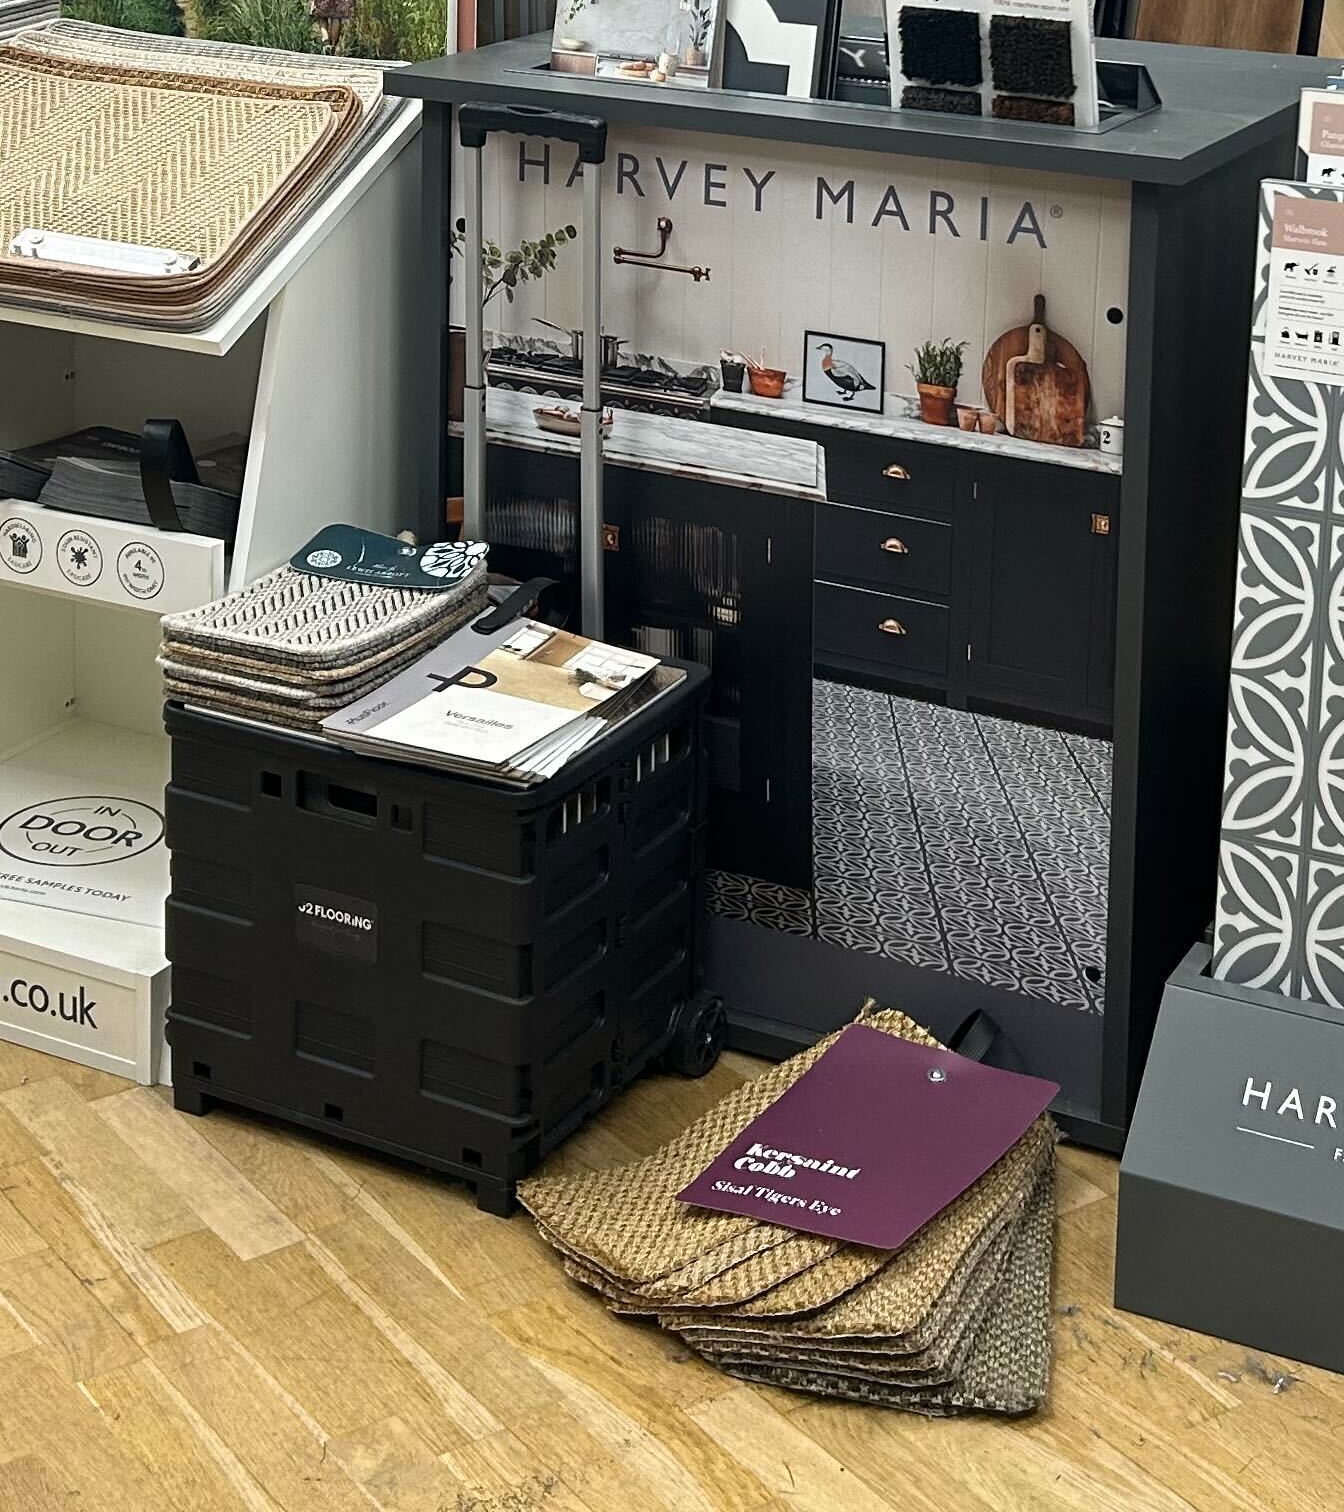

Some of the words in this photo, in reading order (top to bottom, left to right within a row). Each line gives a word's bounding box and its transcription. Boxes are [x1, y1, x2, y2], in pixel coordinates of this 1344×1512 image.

[816, 178, 1048, 249] MARIA
[1283, 223, 1328, 237] Walbrook
[445, 709, 514, 730] Versailles
[94, 805, 123, 817] IN
[19, 814, 144, 848] DOOR
[31, 841, 87, 857] OUT
[25, 877, 83, 894] SAMPLES
[84, 888, 132, 902] TODAY
[733, 1156, 797, 1179] Cobb
[746, 1143, 862, 1180] Kersaint
[711, 1180, 754, 1196] Sisal
[755, 1186, 808, 1209] Tigers
[808, 1199, 842, 1216] Eye
